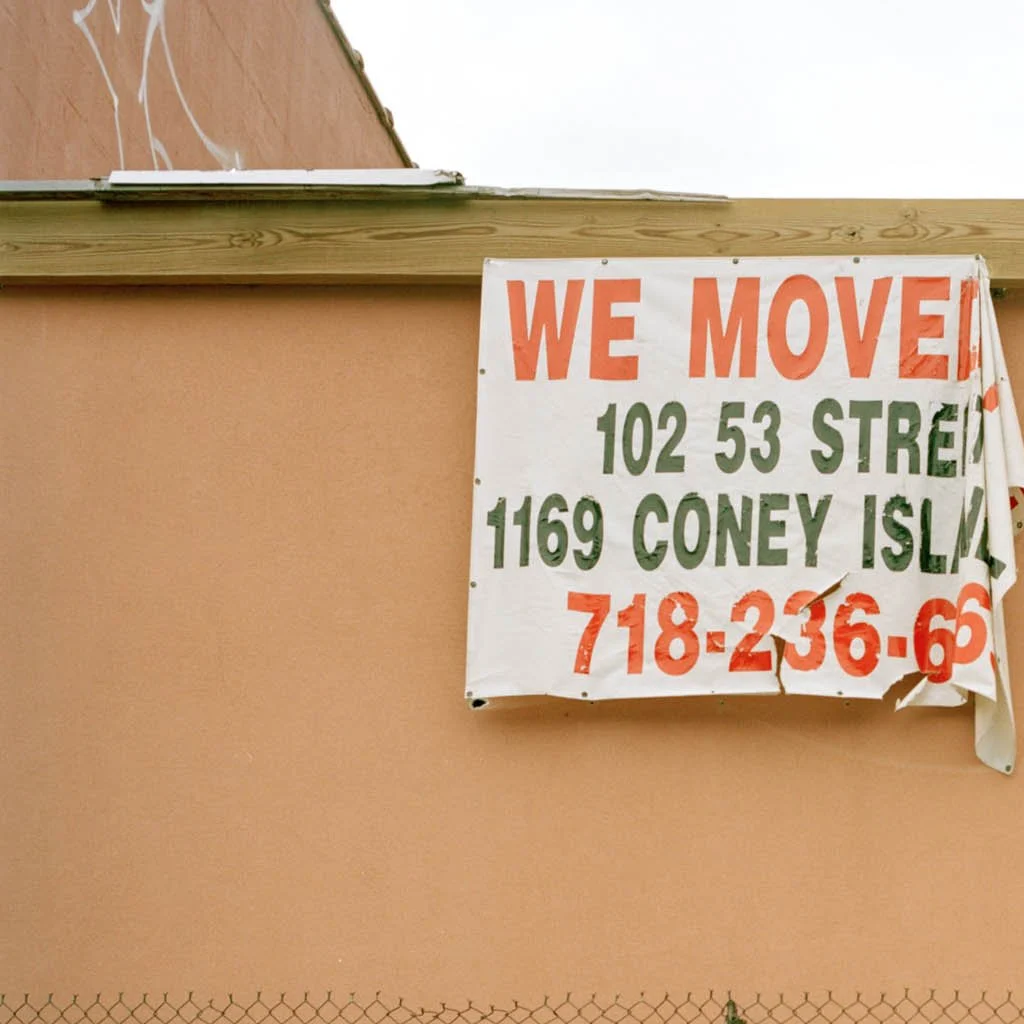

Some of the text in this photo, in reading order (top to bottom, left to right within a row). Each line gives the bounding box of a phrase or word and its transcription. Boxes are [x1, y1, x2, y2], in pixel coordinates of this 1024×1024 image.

[506, 278, 642, 382] WE
[596, 400, 687, 477] 102
[714, 400, 781, 476] 53
[486, 492, 605, 571] 1169
[632, 491, 833, 571] CONEY
